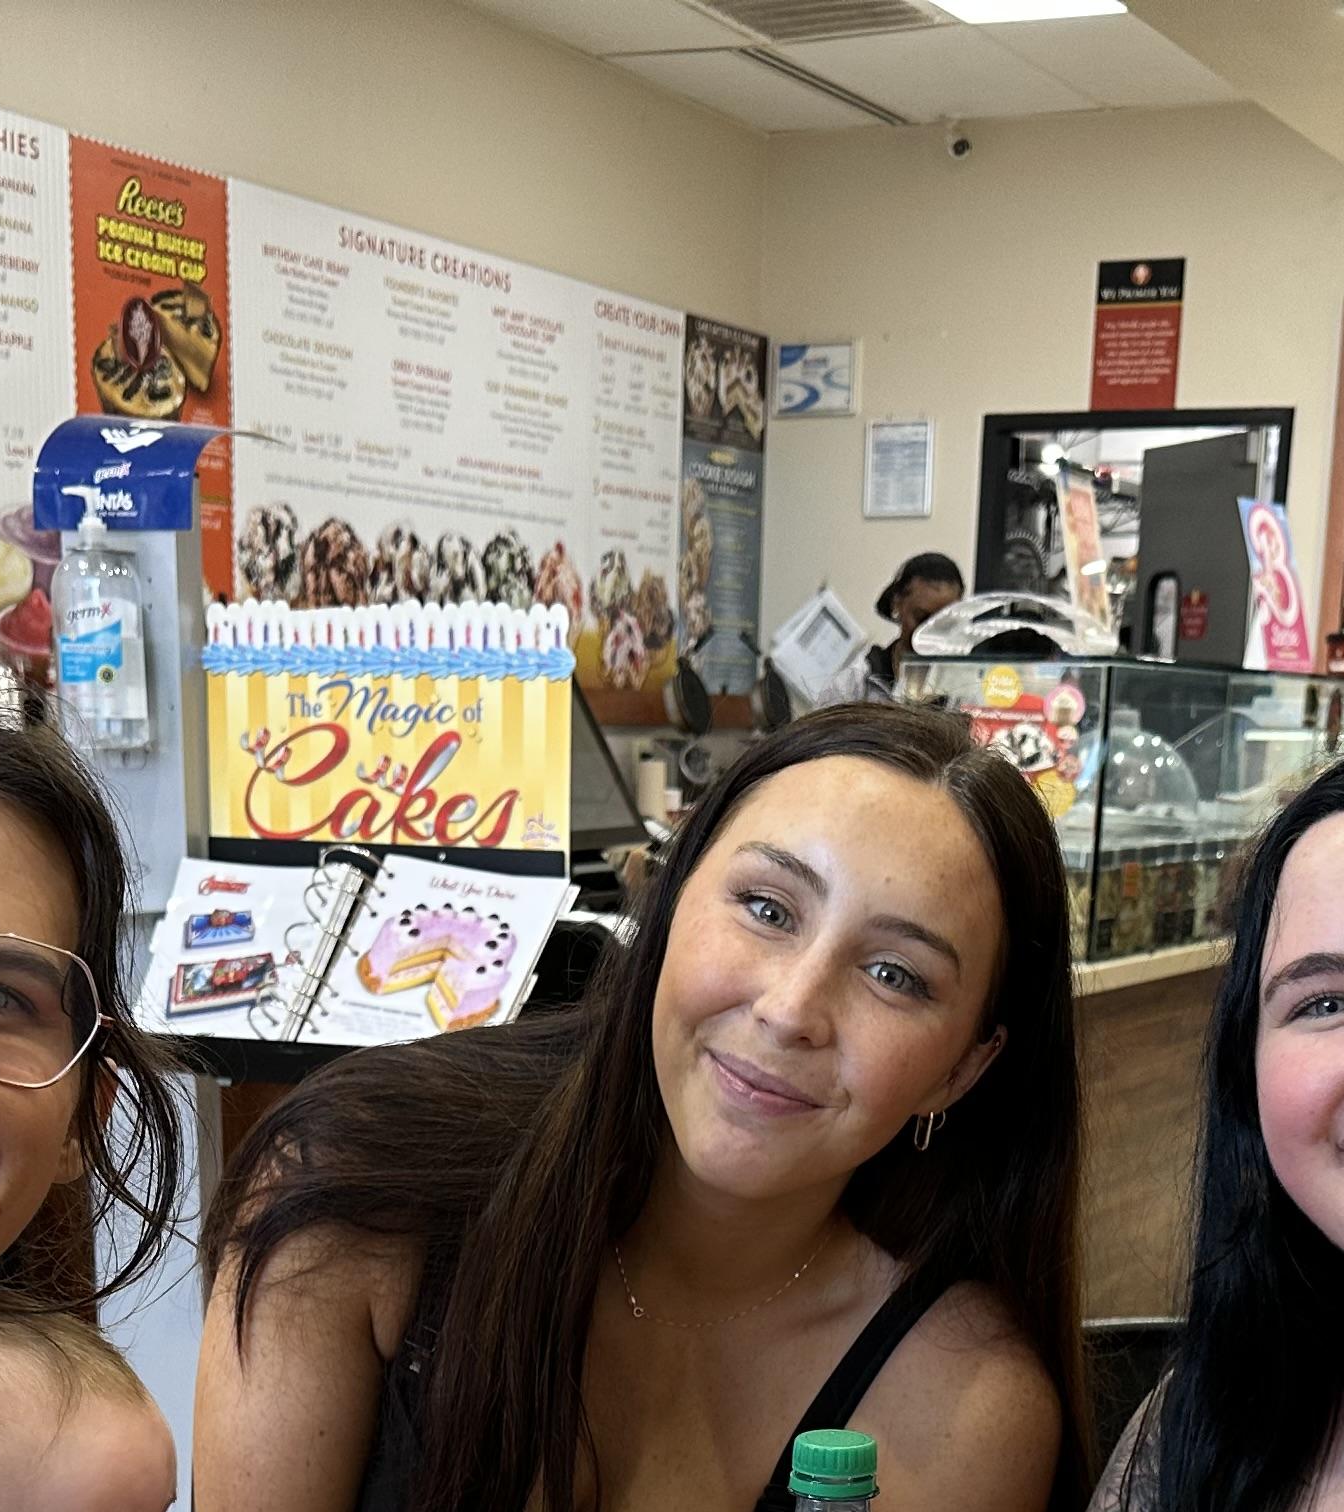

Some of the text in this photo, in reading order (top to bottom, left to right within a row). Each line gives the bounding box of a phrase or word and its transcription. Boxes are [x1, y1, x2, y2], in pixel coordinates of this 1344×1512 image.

[117, 176, 186, 229] Reese's
[338, 225, 512, 294] SIGNATURE CREATIONS
[0, 294, 39, 314] MANGO
[286, 679, 484, 738] The Magic of
[244, 722, 521, 848] Cakes
